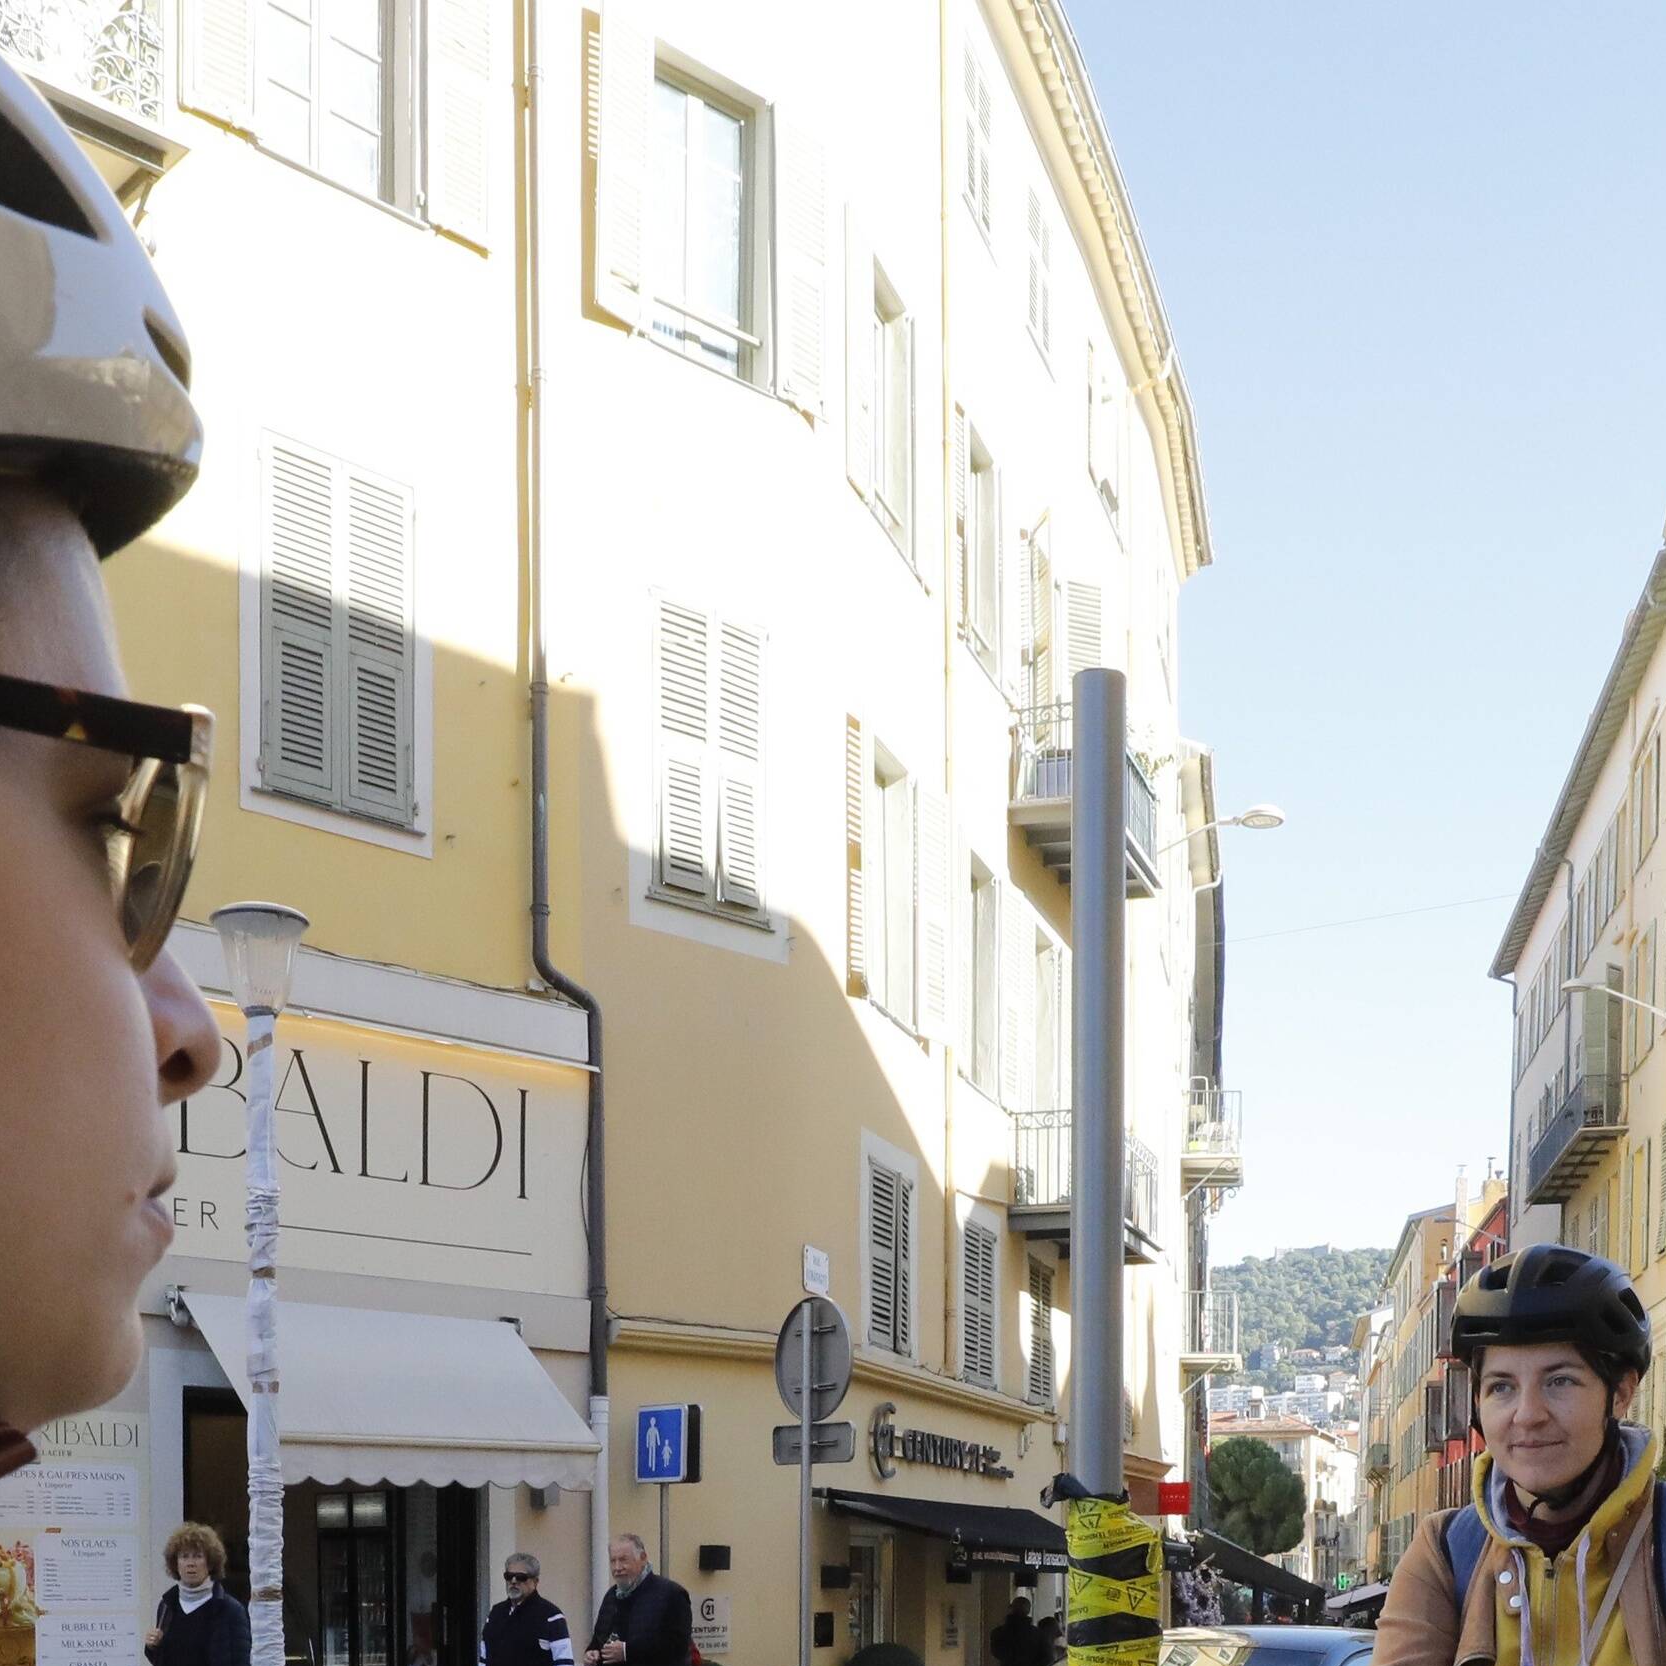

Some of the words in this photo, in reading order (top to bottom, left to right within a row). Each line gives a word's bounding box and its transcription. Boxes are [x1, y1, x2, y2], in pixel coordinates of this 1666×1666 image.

[902, 1429, 970, 1472] CENTURY
[61, 1539, 80, 1549] NOS
[82, 1539, 117, 1549] GLACES
[61, 1623, 96, 1631] BUBBLE
[100, 1622, 116, 1631] TEA
